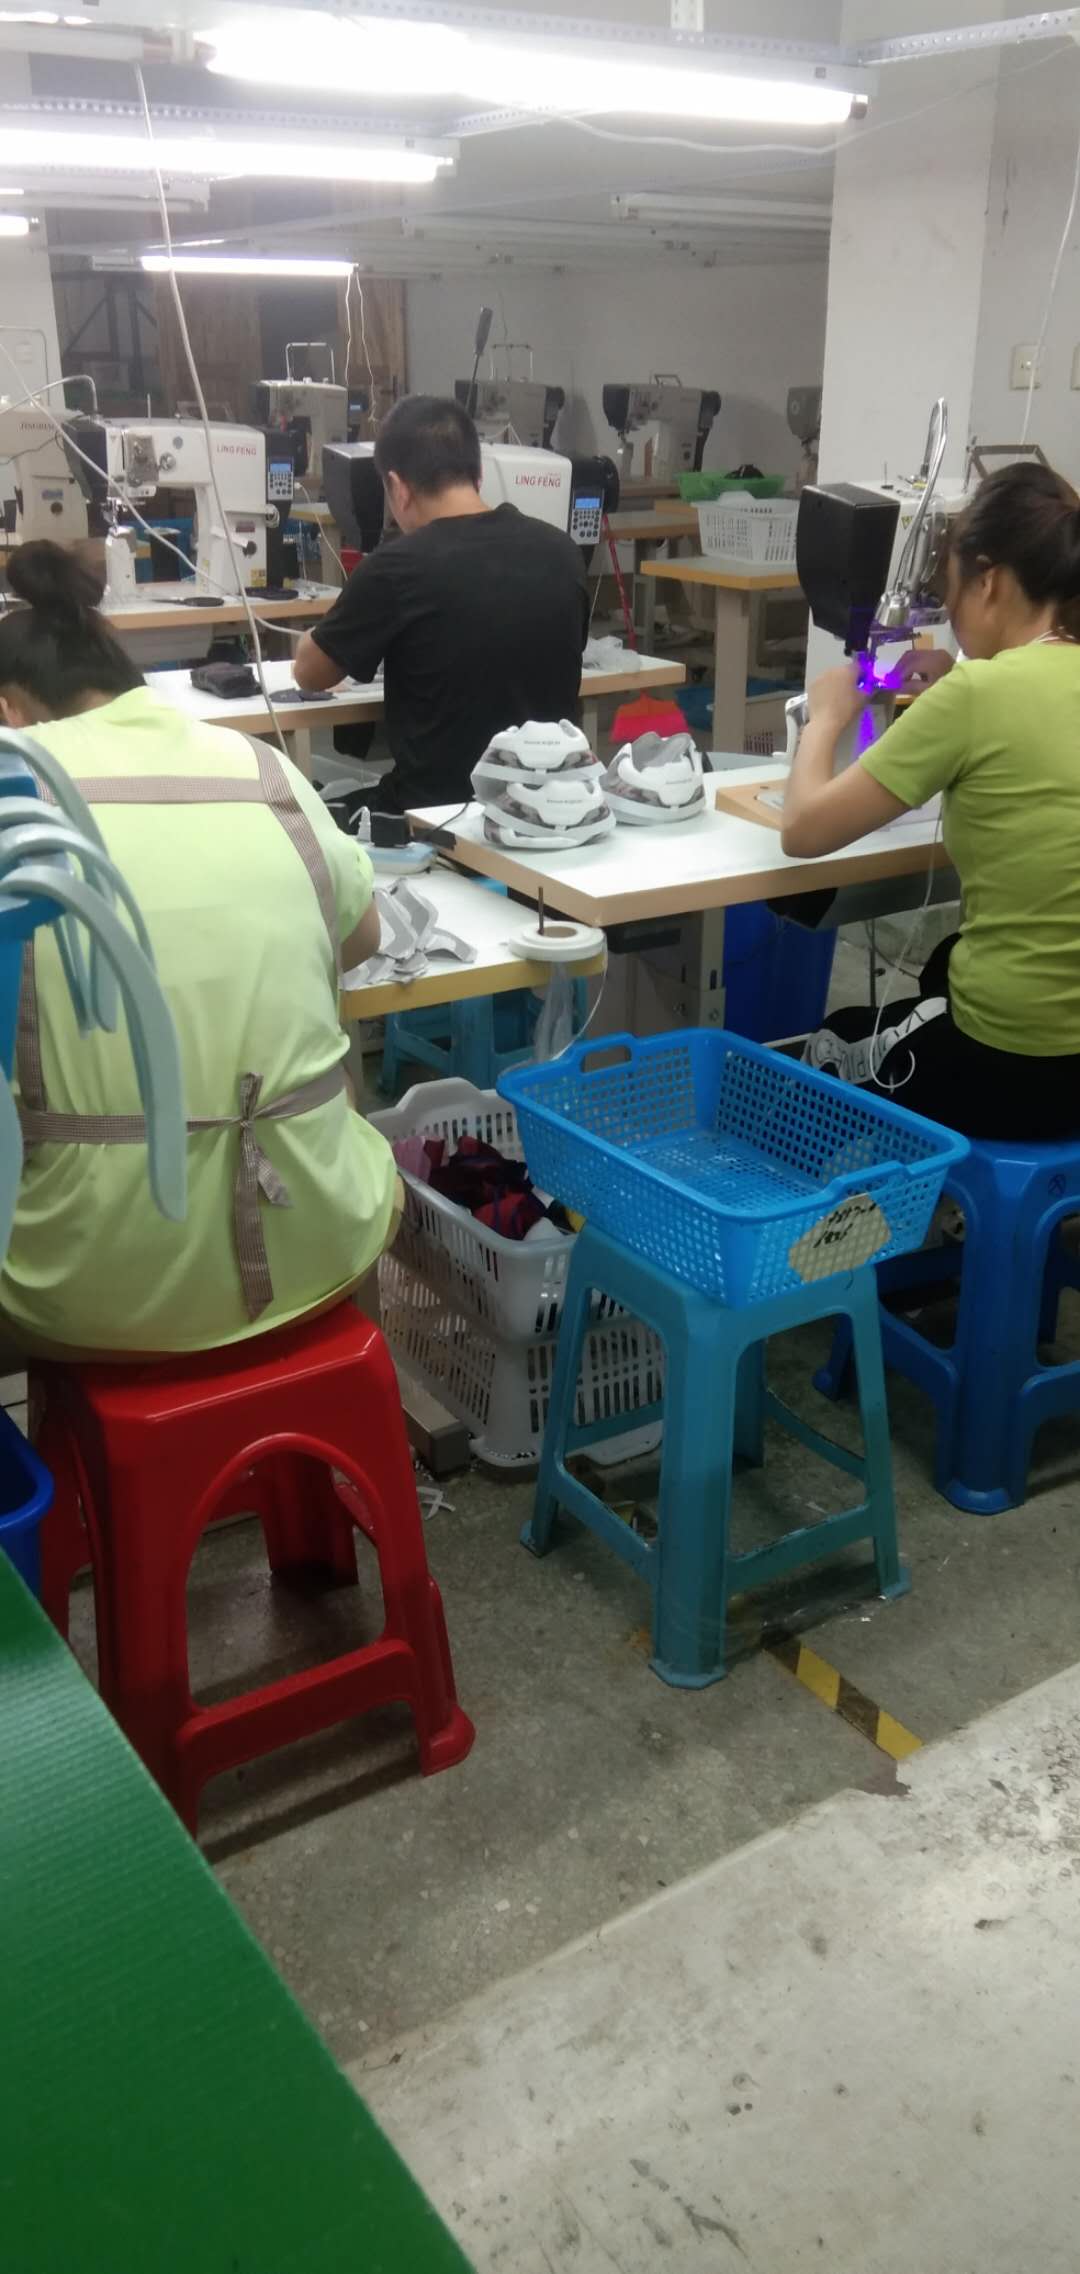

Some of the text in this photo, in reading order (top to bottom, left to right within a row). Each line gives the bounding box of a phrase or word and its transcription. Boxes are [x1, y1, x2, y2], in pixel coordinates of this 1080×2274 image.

[216, 444, 257, 456] LING FENG
[515, 475, 561, 488] LING FENG
